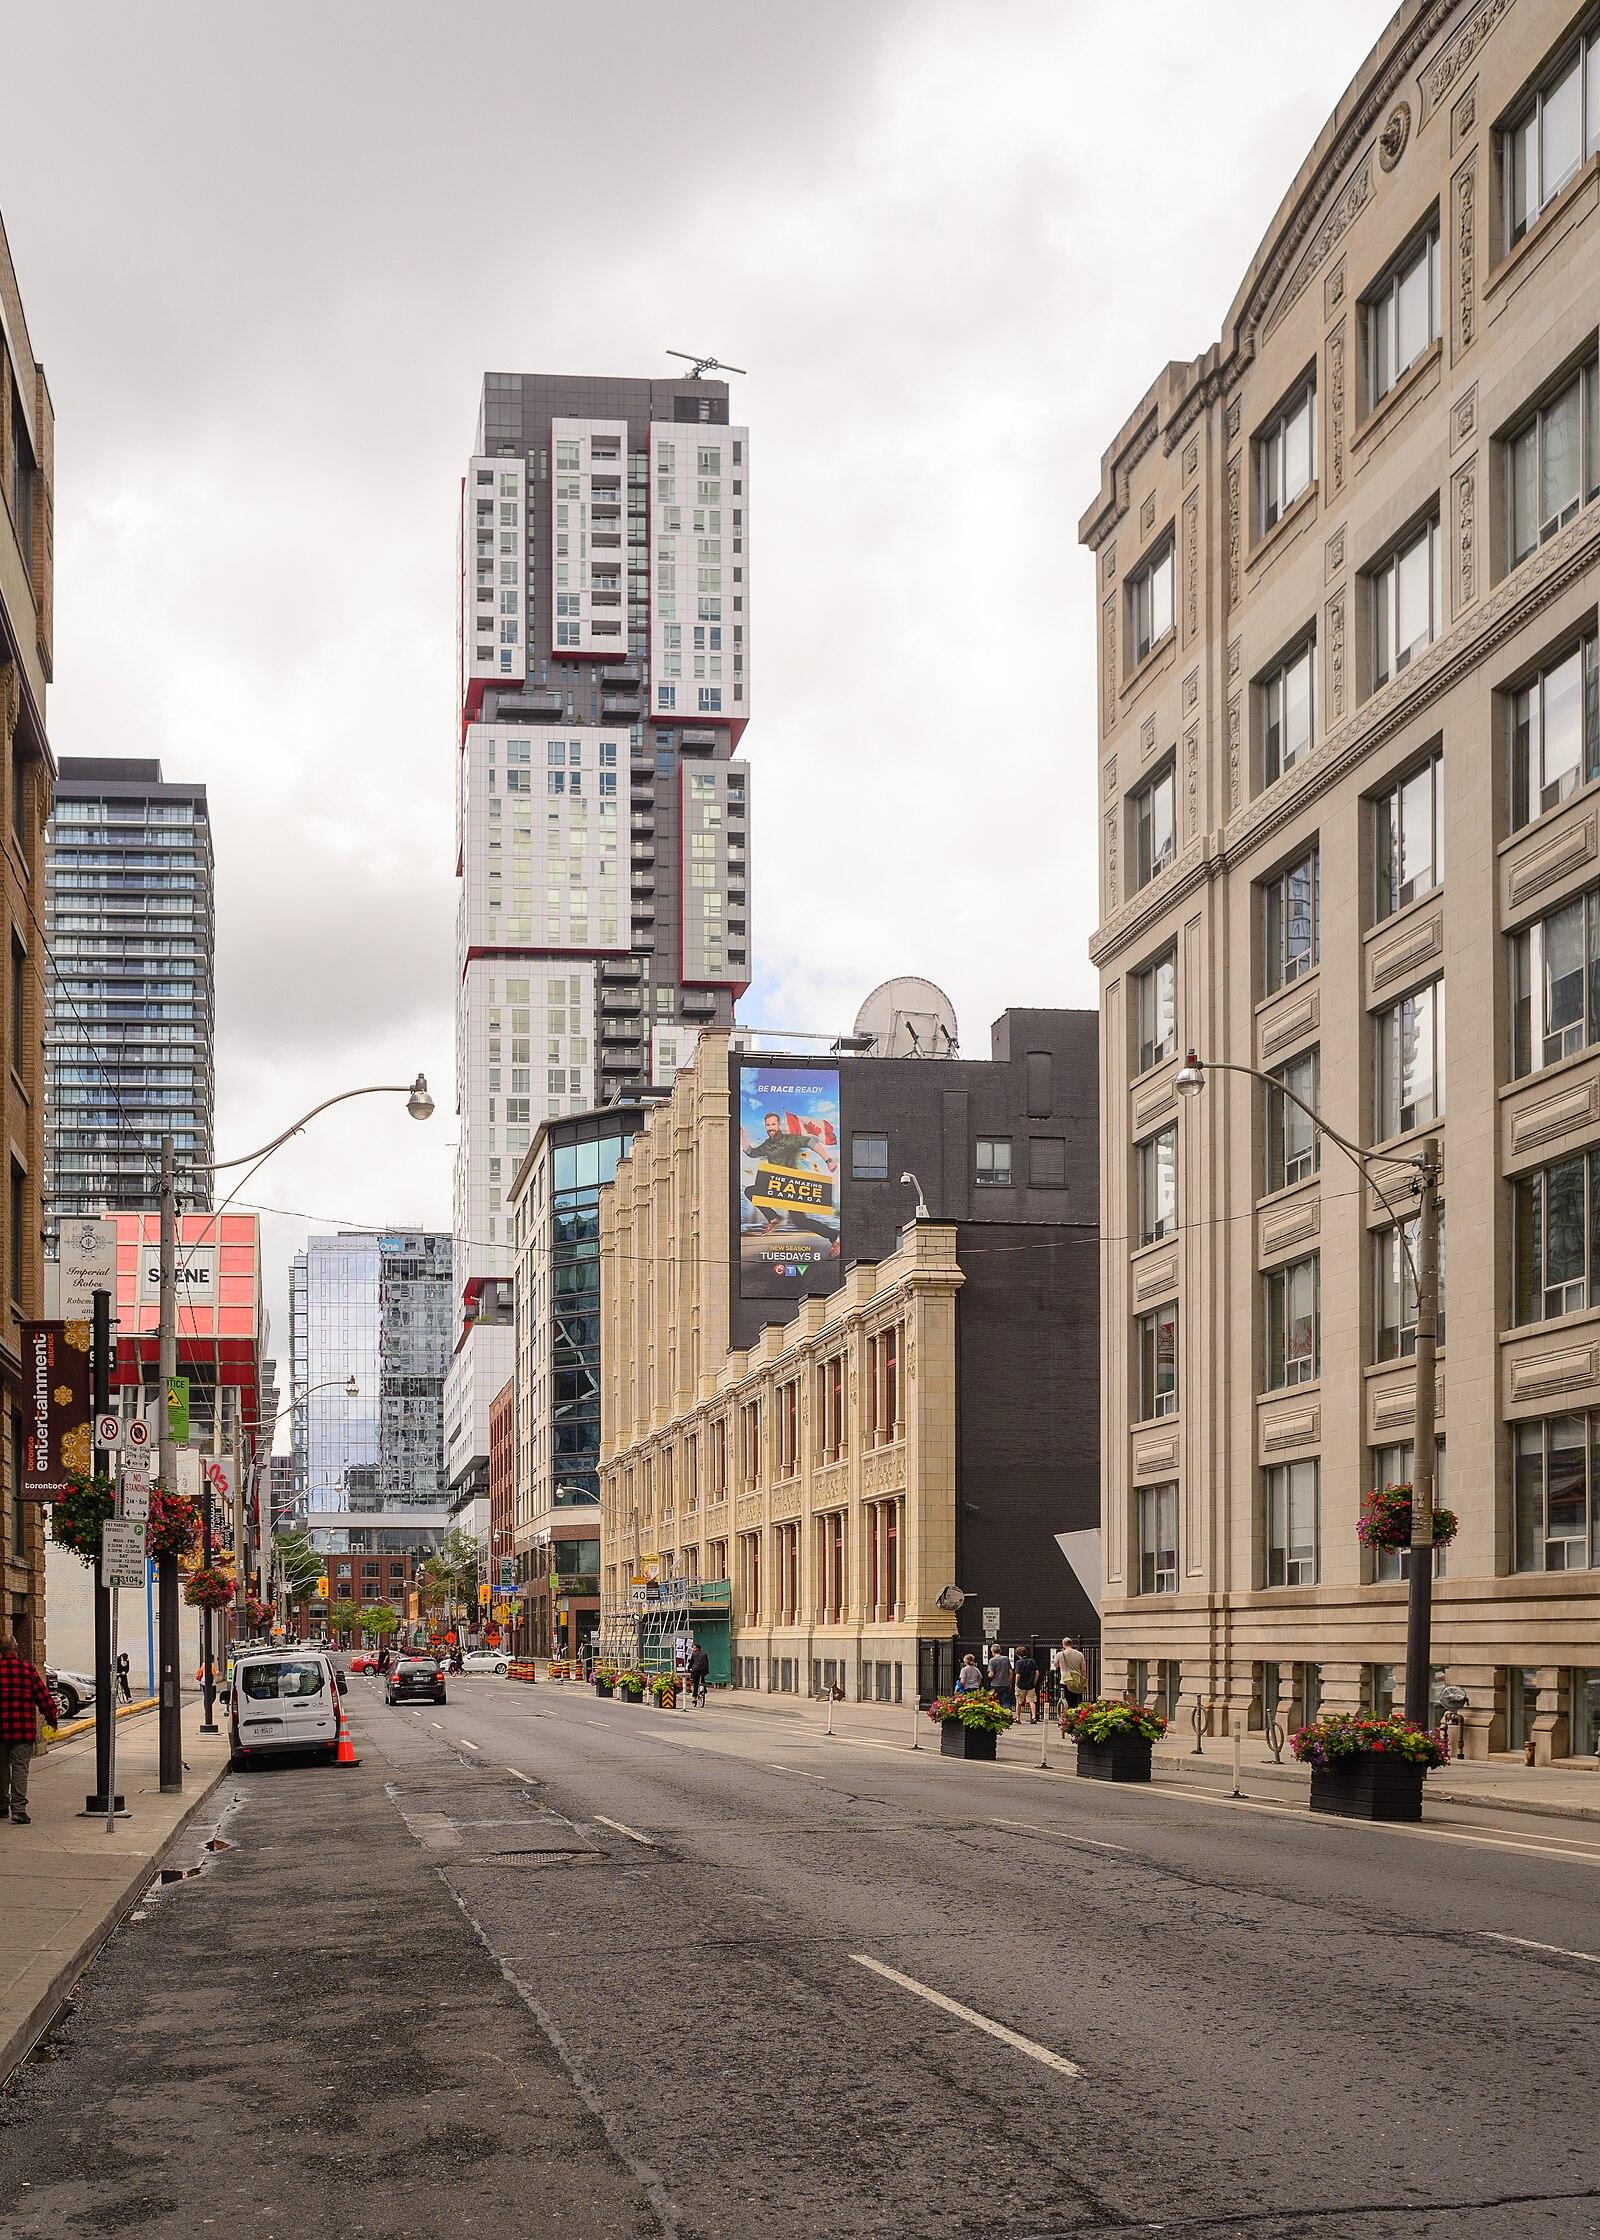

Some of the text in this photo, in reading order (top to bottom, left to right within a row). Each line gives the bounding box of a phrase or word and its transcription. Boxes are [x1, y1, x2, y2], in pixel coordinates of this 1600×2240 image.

[758, 1085, 824, 1094] BE RACE READY
[770, 1175, 823, 1189] THE AMAZING
[767, 1180, 822, 1198] RACE
[767, 1190, 822, 1203] CANADA
[379, 1242, 399, 1251] One
[760, 1252, 821, 1261] TUESDAYS 8
[66, 1267, 110, 1279] Imperial
[147, 1268, 210, 1283] SENE
[774, 1264, 810, 1277] CTV
[72, 1278, 103, 1288] Robes
[33, 1333, 48, 1472] entertainment
[27, 1436, 35, 1472] toronto
[133, 1474, 142, 1483] NO
[125, 1483, 149, 1493] STANDING
[632, 1591, 646, 1600] 40
